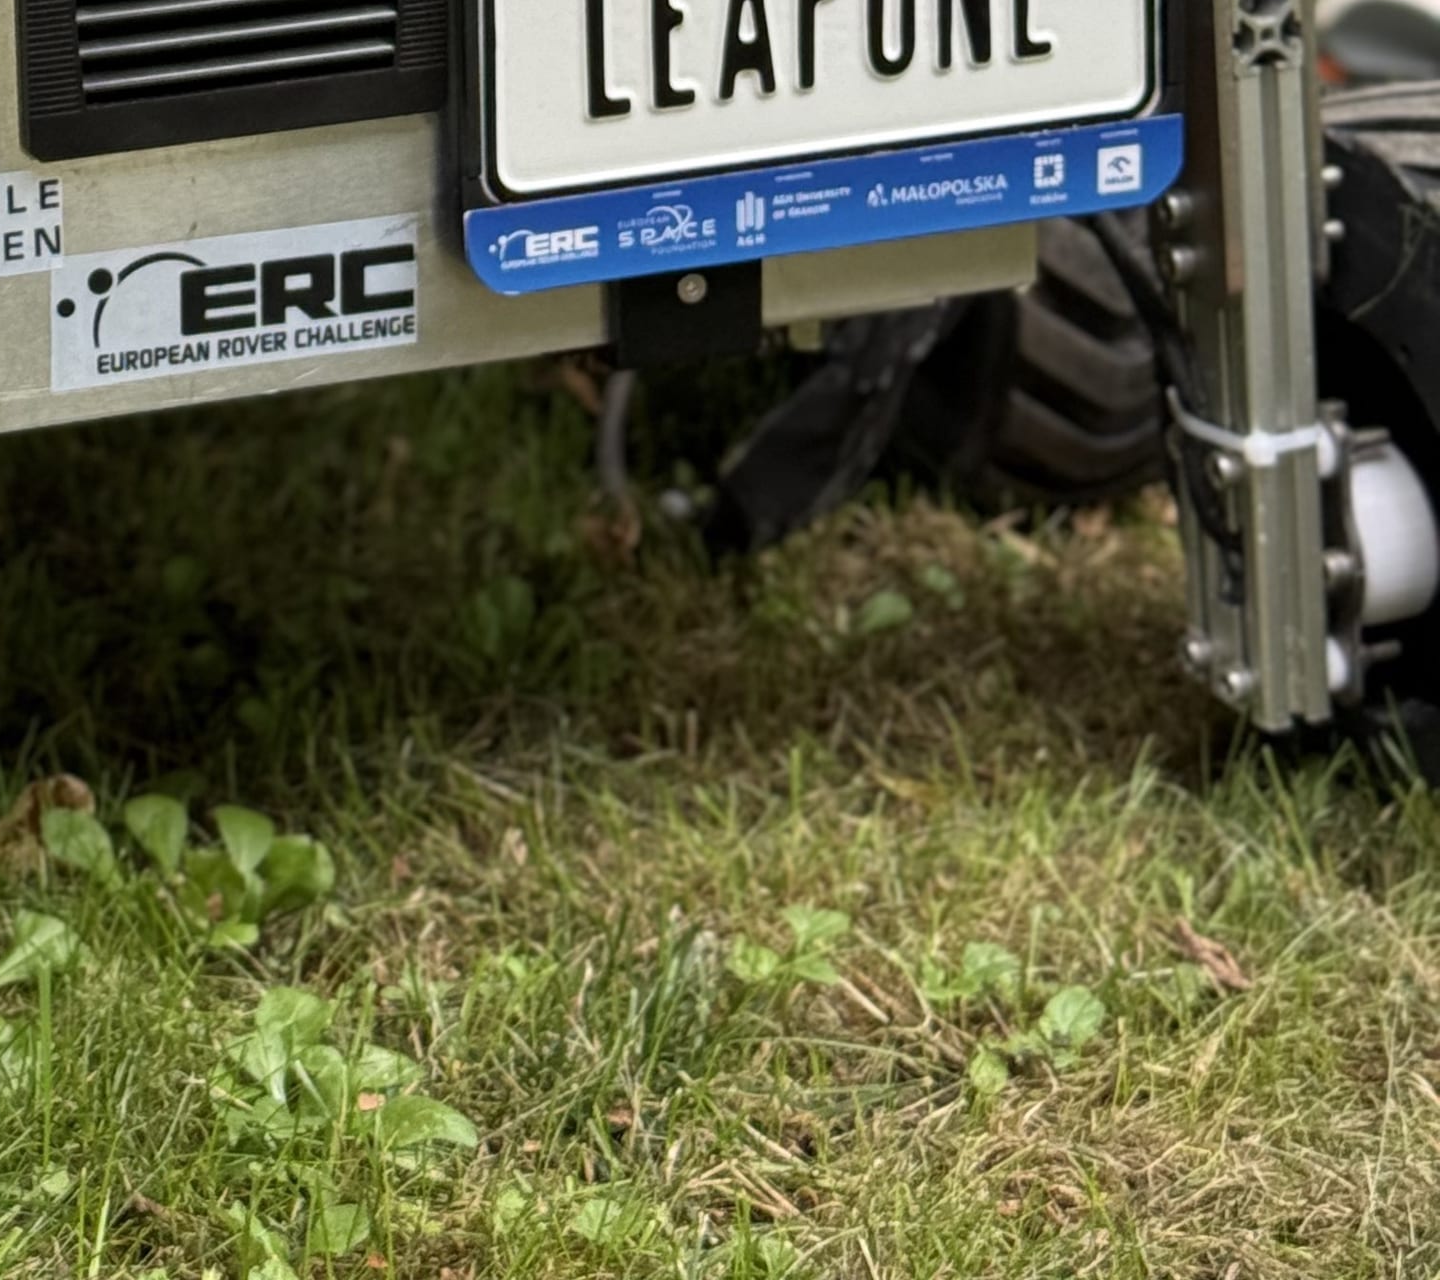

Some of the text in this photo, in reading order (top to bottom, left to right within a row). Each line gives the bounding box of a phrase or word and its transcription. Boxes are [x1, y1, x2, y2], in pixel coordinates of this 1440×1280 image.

[891, 174, 1008, 205] MAŁOPOLSKA
[525, 226, 600, 258] ERC
[618, 218, 717, 249] SPACE
[180, 243, 415, 336] ERC
[97, 314, 416, 374] EUROPEAN ROVER CHALLENGE
